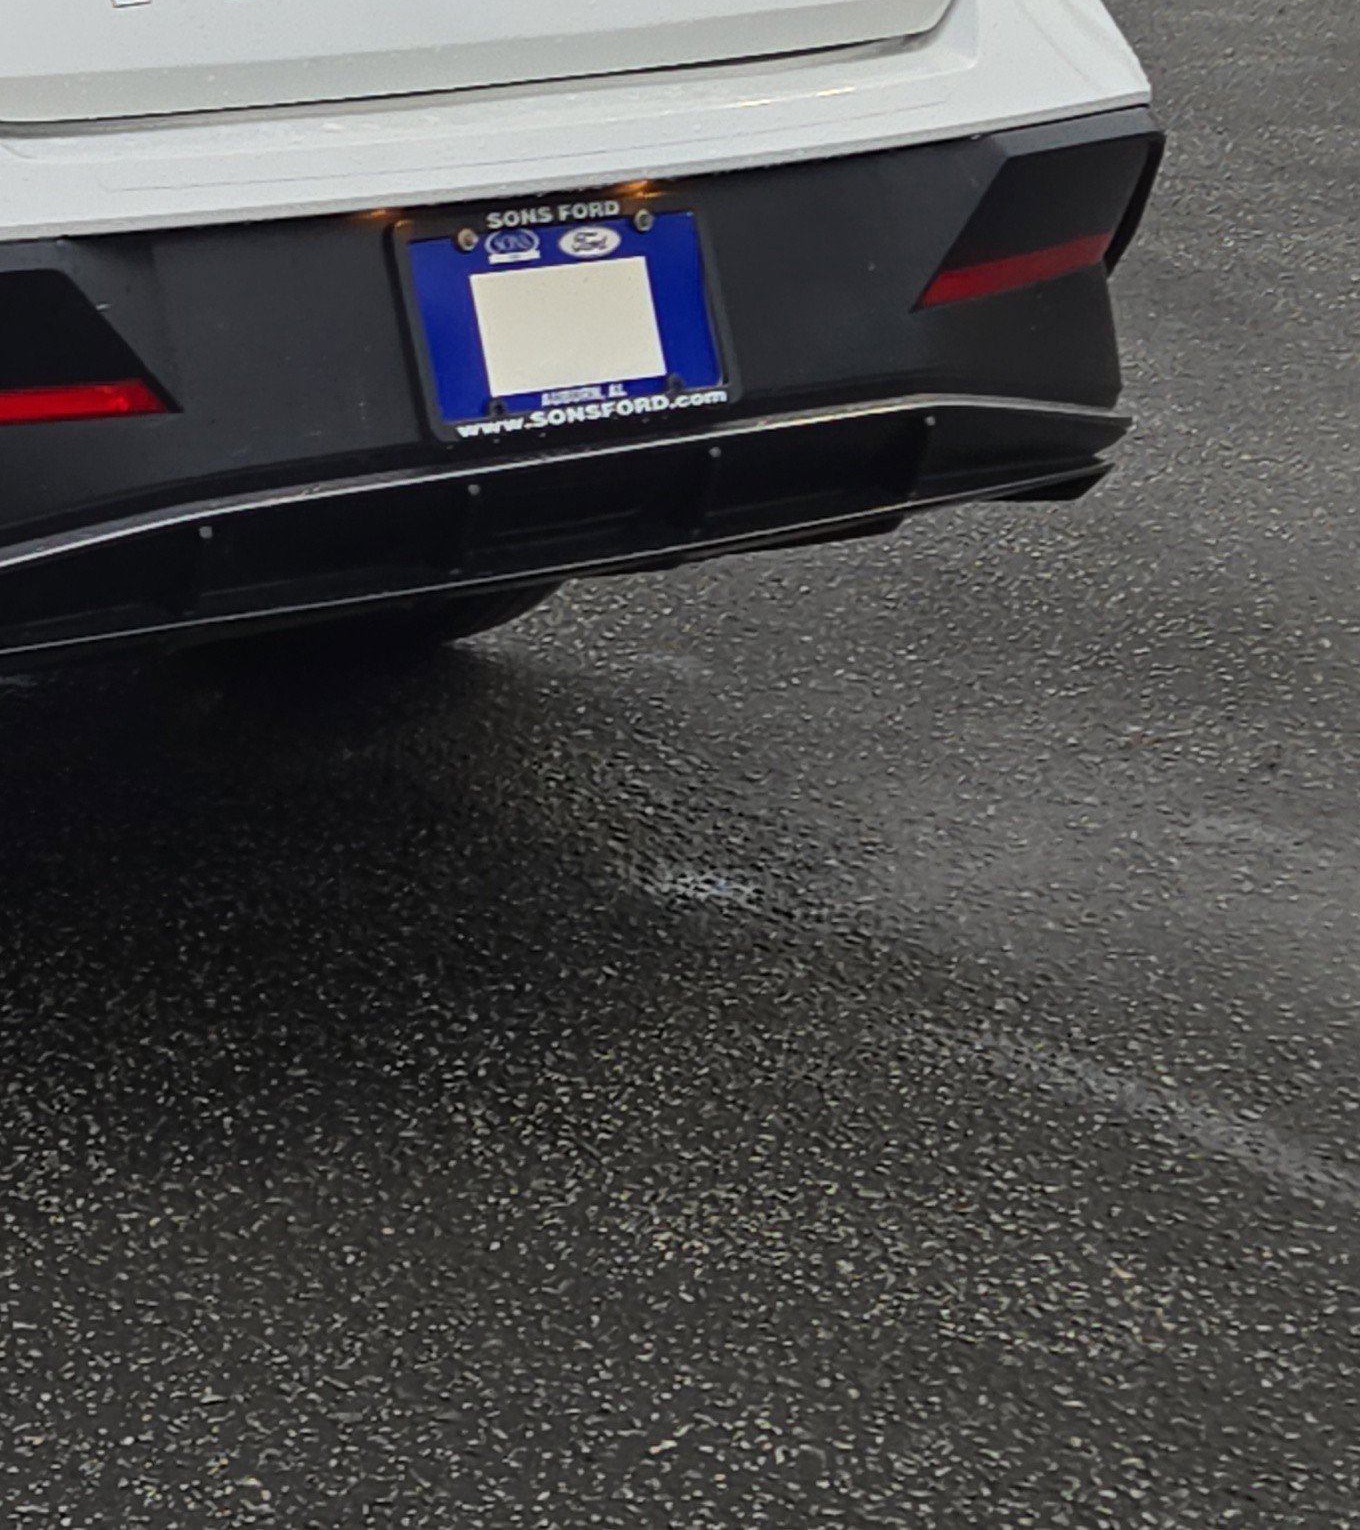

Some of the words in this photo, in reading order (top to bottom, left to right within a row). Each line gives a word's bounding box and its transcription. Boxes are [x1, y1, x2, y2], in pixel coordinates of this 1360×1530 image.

[487, 206, 553, 228] SONS
[557, 200, 620, 221] FORD
[457, 391, 727, 438] www.SONSFORD.com
